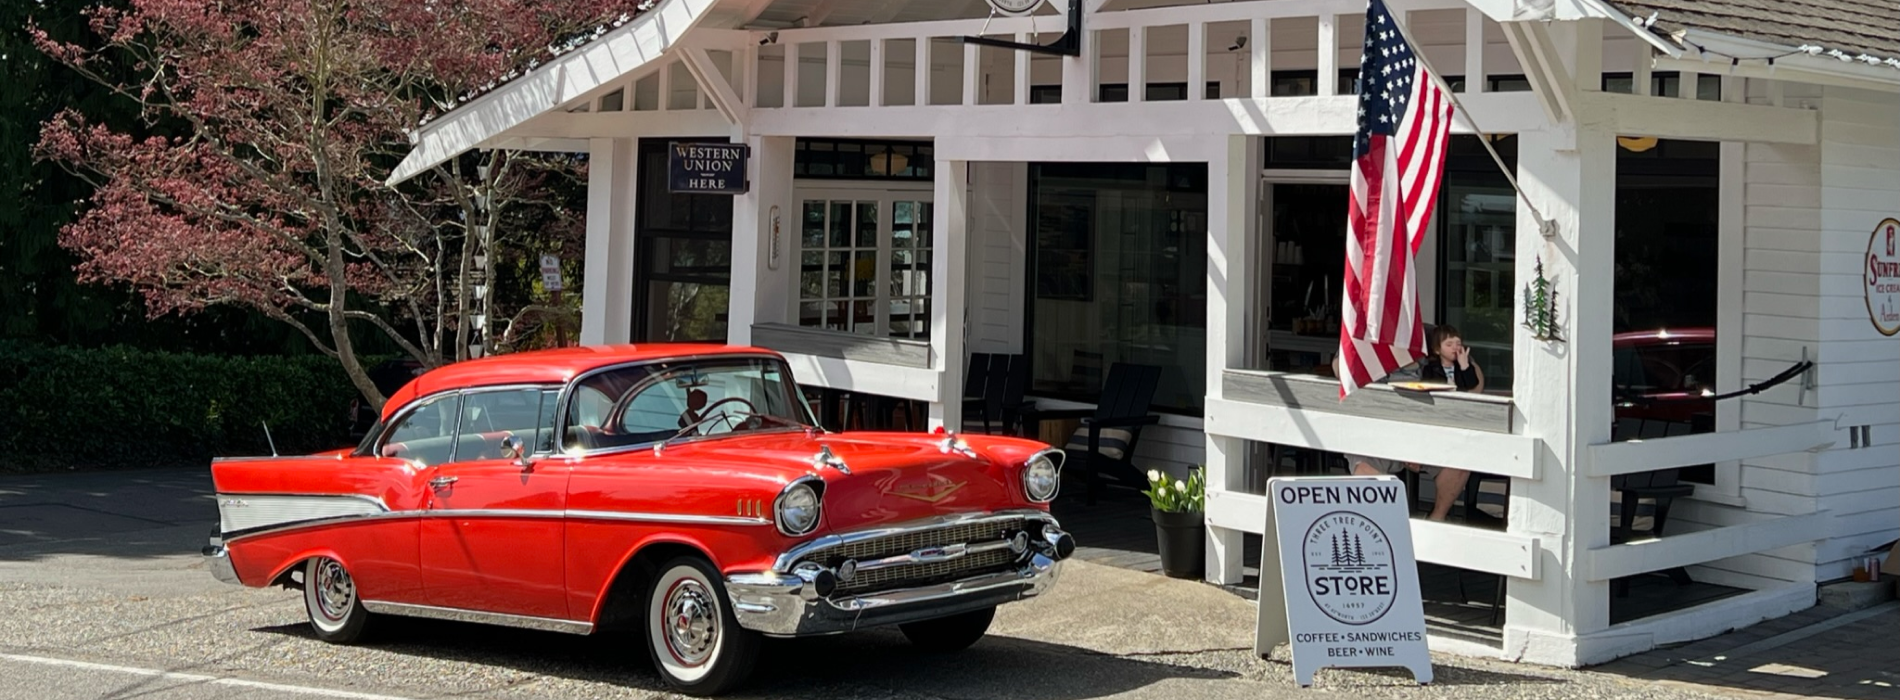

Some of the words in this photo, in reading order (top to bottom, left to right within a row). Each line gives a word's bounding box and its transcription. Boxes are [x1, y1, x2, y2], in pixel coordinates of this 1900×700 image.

[676, 147, 740, 160] WESTERN
[684, 159, 733, 172] UNION
[689, 178, 726, 189] HERE
[1869, 254, 1900, 286] SUNFR
[1876, 284, 1885, 293] ICE
[1281, 487, 1341, 504] OPEN
[1346, 486, 1398, 504] NOW
[1310, 521, 1330, 544] THREE
[1333, 517, 1355, 525] TREE
[1359, 521, 1383, 544] POINT
[1315, 576, 1390, 595] STORE
[1296, 632, 1340, 643] COFFEE
[1347, 631, 1422, 643] SANDWICHES
[1328, 647, 1357, 657] BEER
[1365, 646, 1395, 657] WINE
